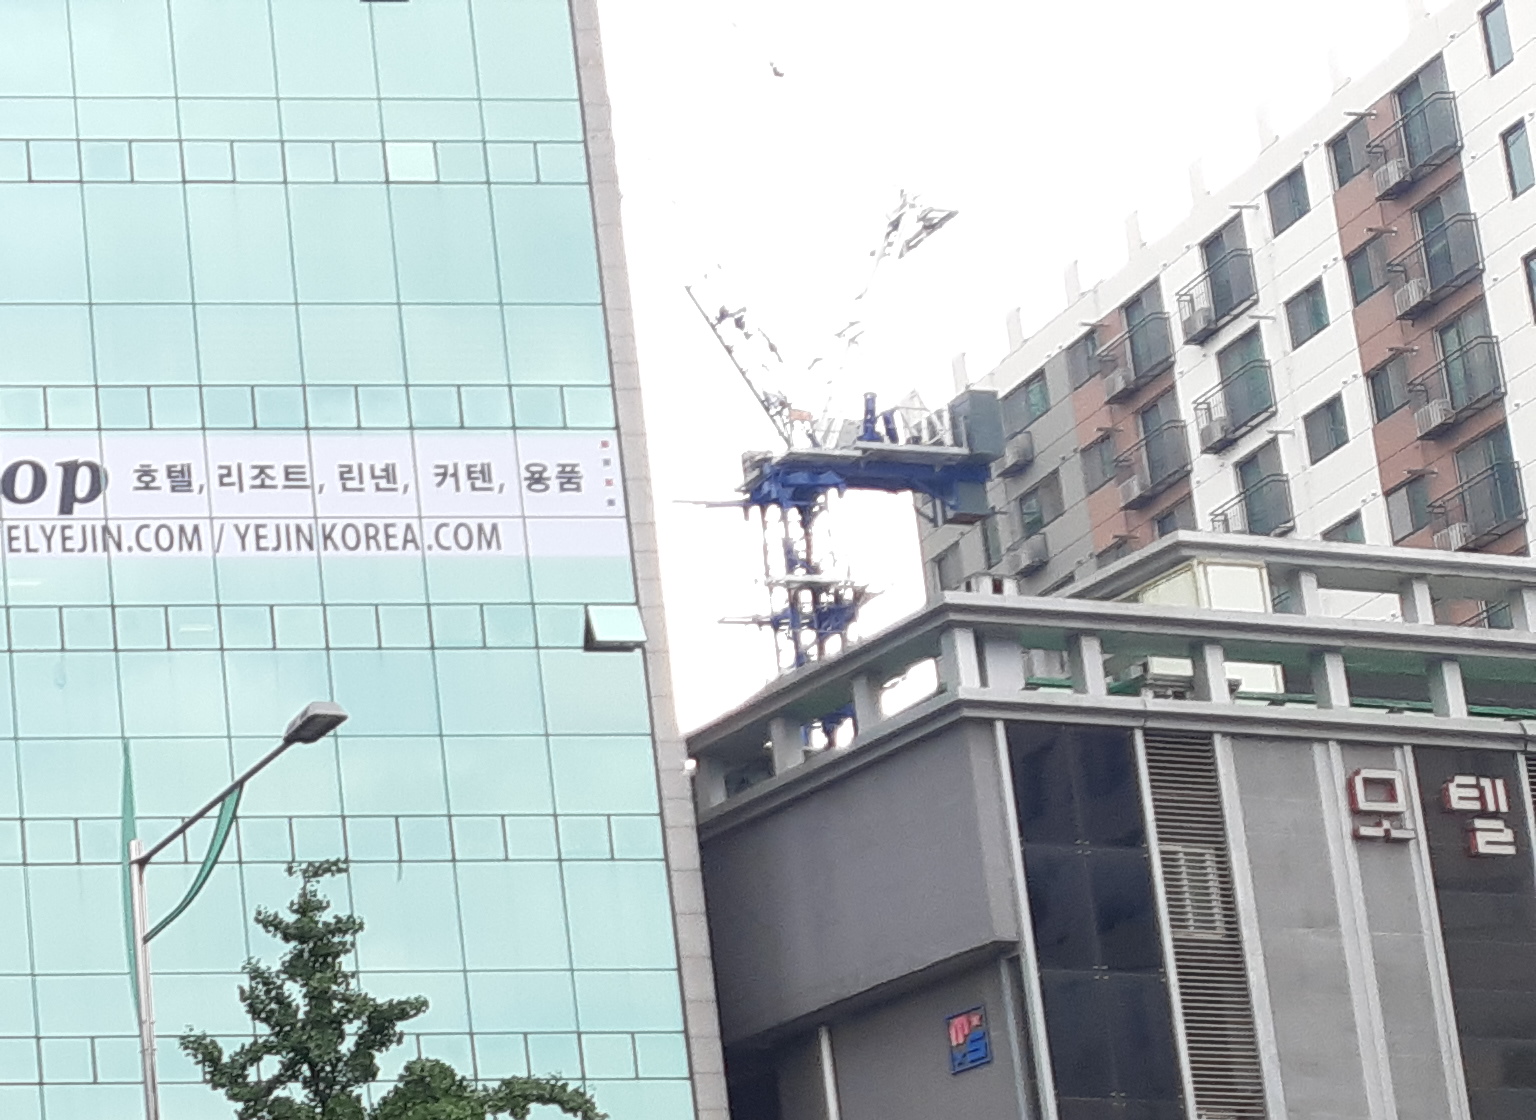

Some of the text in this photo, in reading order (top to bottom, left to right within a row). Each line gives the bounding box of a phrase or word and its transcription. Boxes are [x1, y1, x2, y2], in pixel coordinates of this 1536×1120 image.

[131, 461, 207, 495] 호텔,
[216, 462, 326, 495] 리조트,
[523, 462, 584, 494] 용품
[233, 522, 503, 553] YEJINKOREA.COM
